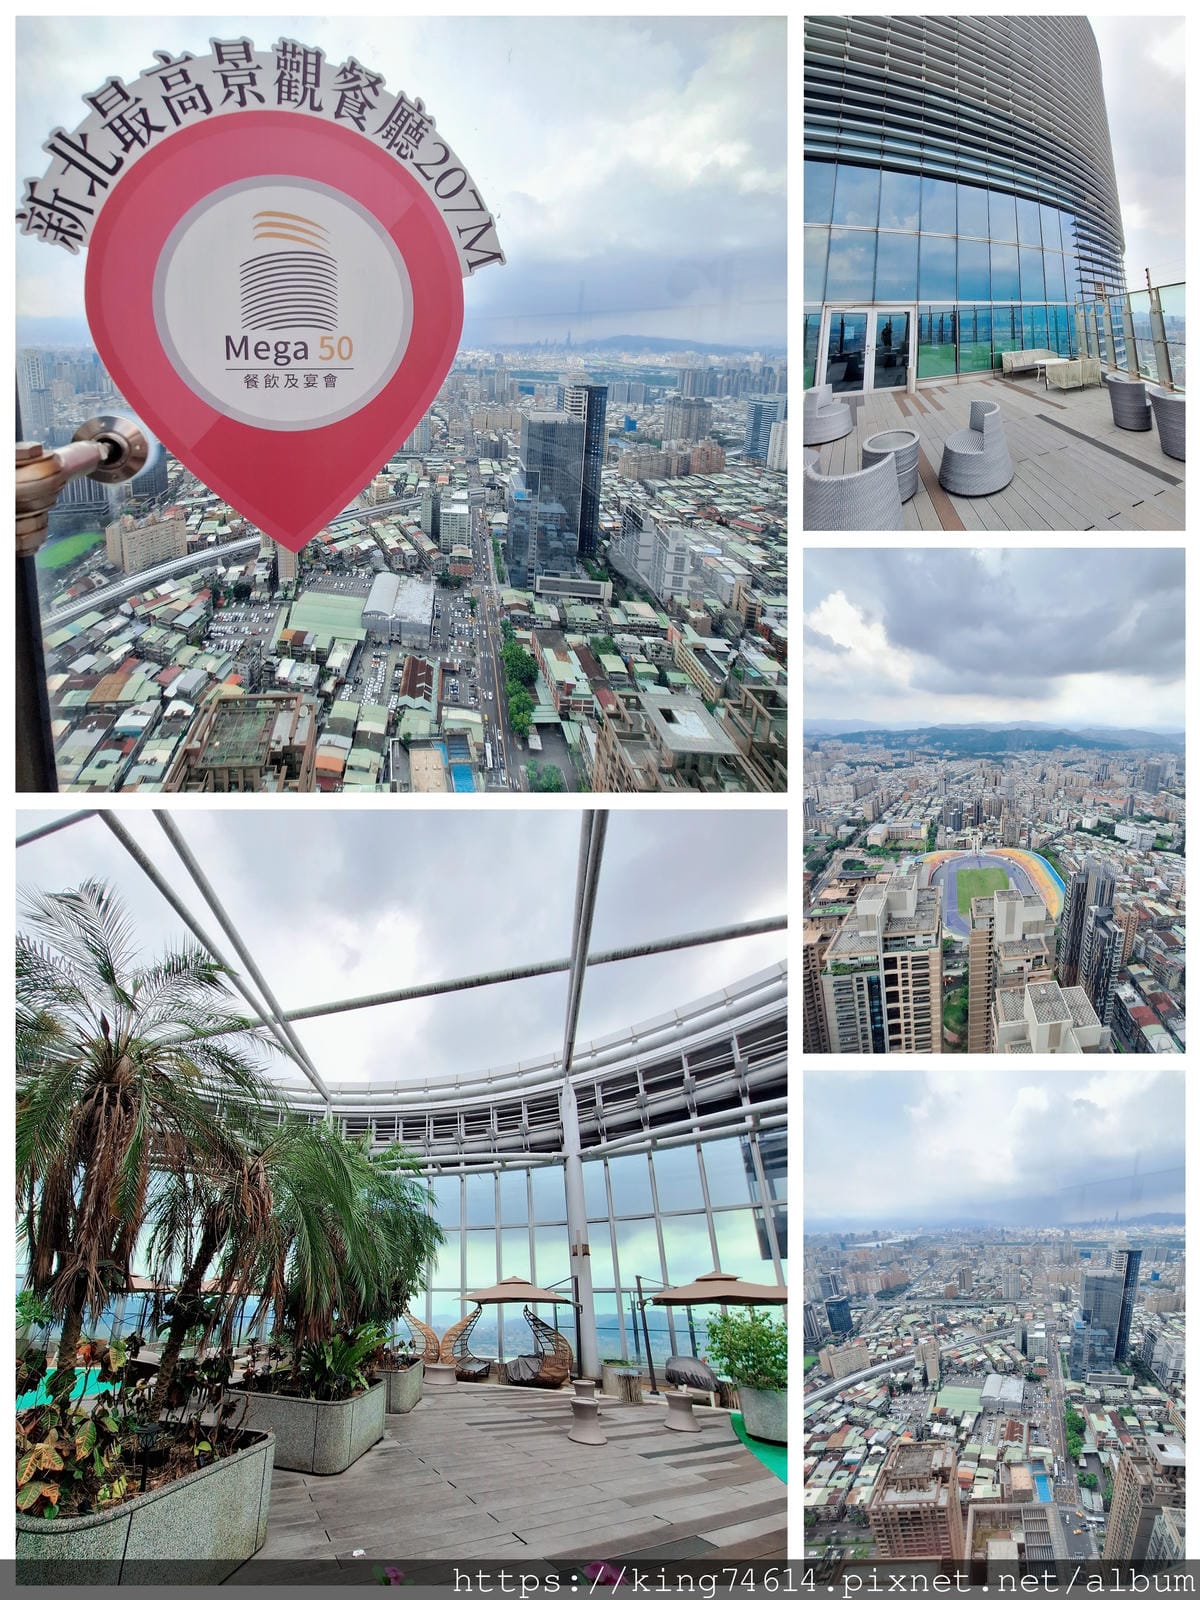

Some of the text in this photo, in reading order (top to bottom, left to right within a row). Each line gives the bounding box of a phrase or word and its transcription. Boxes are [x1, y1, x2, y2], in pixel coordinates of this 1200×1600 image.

[16, 40, 505, 273] 新北最高景觀餐廳207M
[225, 335, 353, 365] Mega 50
[243, 373, 338, 389] 餐飲及宴會
